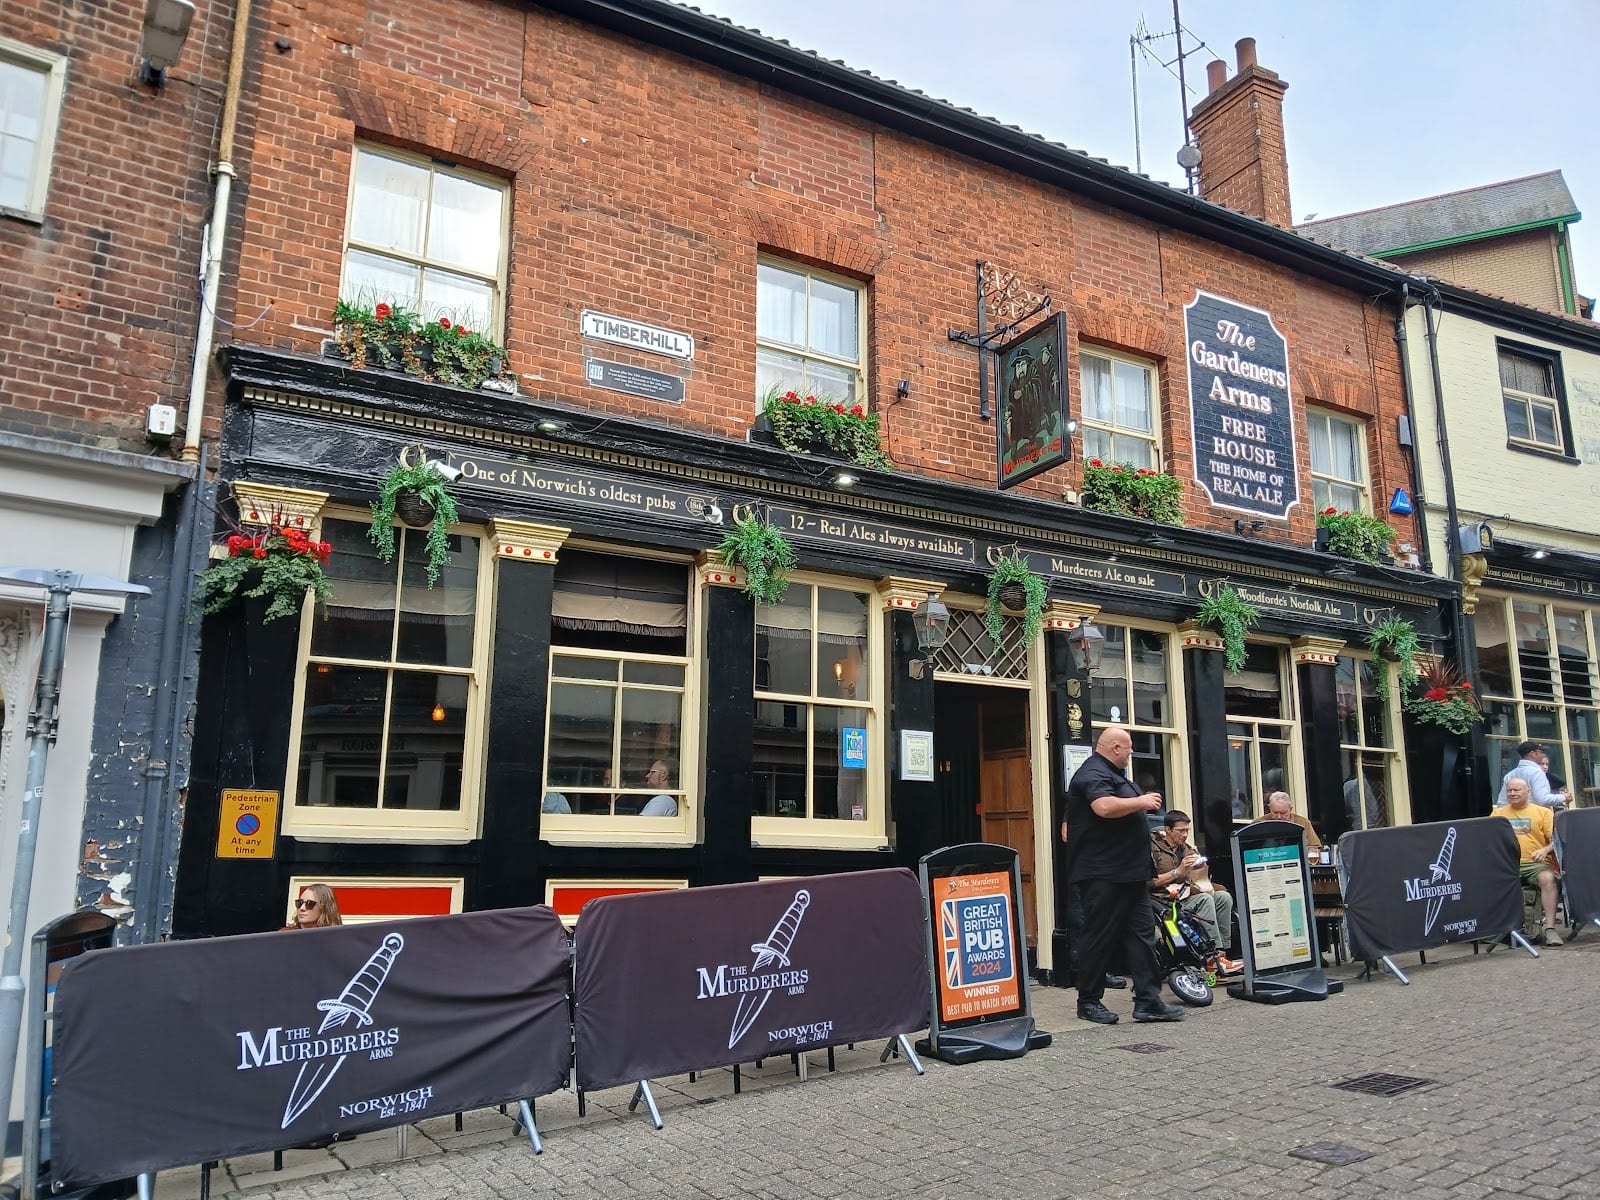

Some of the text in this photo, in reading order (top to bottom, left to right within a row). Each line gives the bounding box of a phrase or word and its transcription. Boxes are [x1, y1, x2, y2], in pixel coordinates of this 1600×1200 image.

[593, 318, 682, 352] TIMBERHILL
[1216, 320, 1256, 351] The
[1191, 340, 1287, 389] Gardeners
[1209, 376, 1272, 414] Arms
[1221, 415, 1266, 443] FREE
[1212, 437, 1276, 468] HOUSE
[1209, 459, 1284, 487] THE HOME OF
[460, 461, 495, 481] One
[500, 470, 516, 485] of
[522, 471, 596, 497] Norwich's
[600, 486, 642, 504] oldest
[646, 494, 676, 511] pubs
[1213, 476, 1283, 505] REAL ALE
[790, 514, 804, 530] 12
[820, 520, 846, 537] Real
[849, 526, 876, 541] Ales
[878, 530, 915, 550] always
[917, 538, 964, 555] available
[1051, 559, 1155, 587] Murderers Ale on sale
[1290, 595, 1322, 613] Norfolk
[1325, 605, 1341, 616] Ales
[226, 794, 274, 802] Pedestrian
[231, 837, 241, 845] At
[1404, 878, 1462, 902] MURDERERS
[963, 903, 1001, 920] GREAT
[964, 917, 1003, 932] BRITISH
[1444, 919, 1477, 932] NORWICH
[965, 929, 1005, 952] PUB
[967, 949, 1006, 964] AWARDS
[730, 966, 747, 976] THE
[971, 962, 1001, 977] 2024
[696, 965, 808, 999] MURDERERS
[788, 985, 805, 996] ARMS
[964, 984, 1000, 998] WINNER
[947, 994, 1017, 1016] BEST PUB TO WATCH SPORT
[286, 1027, 310, 1041] THE
[768, 1021, 833, 1042] NORWICH
[236, 1027, 399, 1070] MURDERERS
[369, 1047, 393, 1060] ARMS
[339, 1086, 434, 1118] NORWICH
[380, 1100, 428, 1119] Est. -1841
